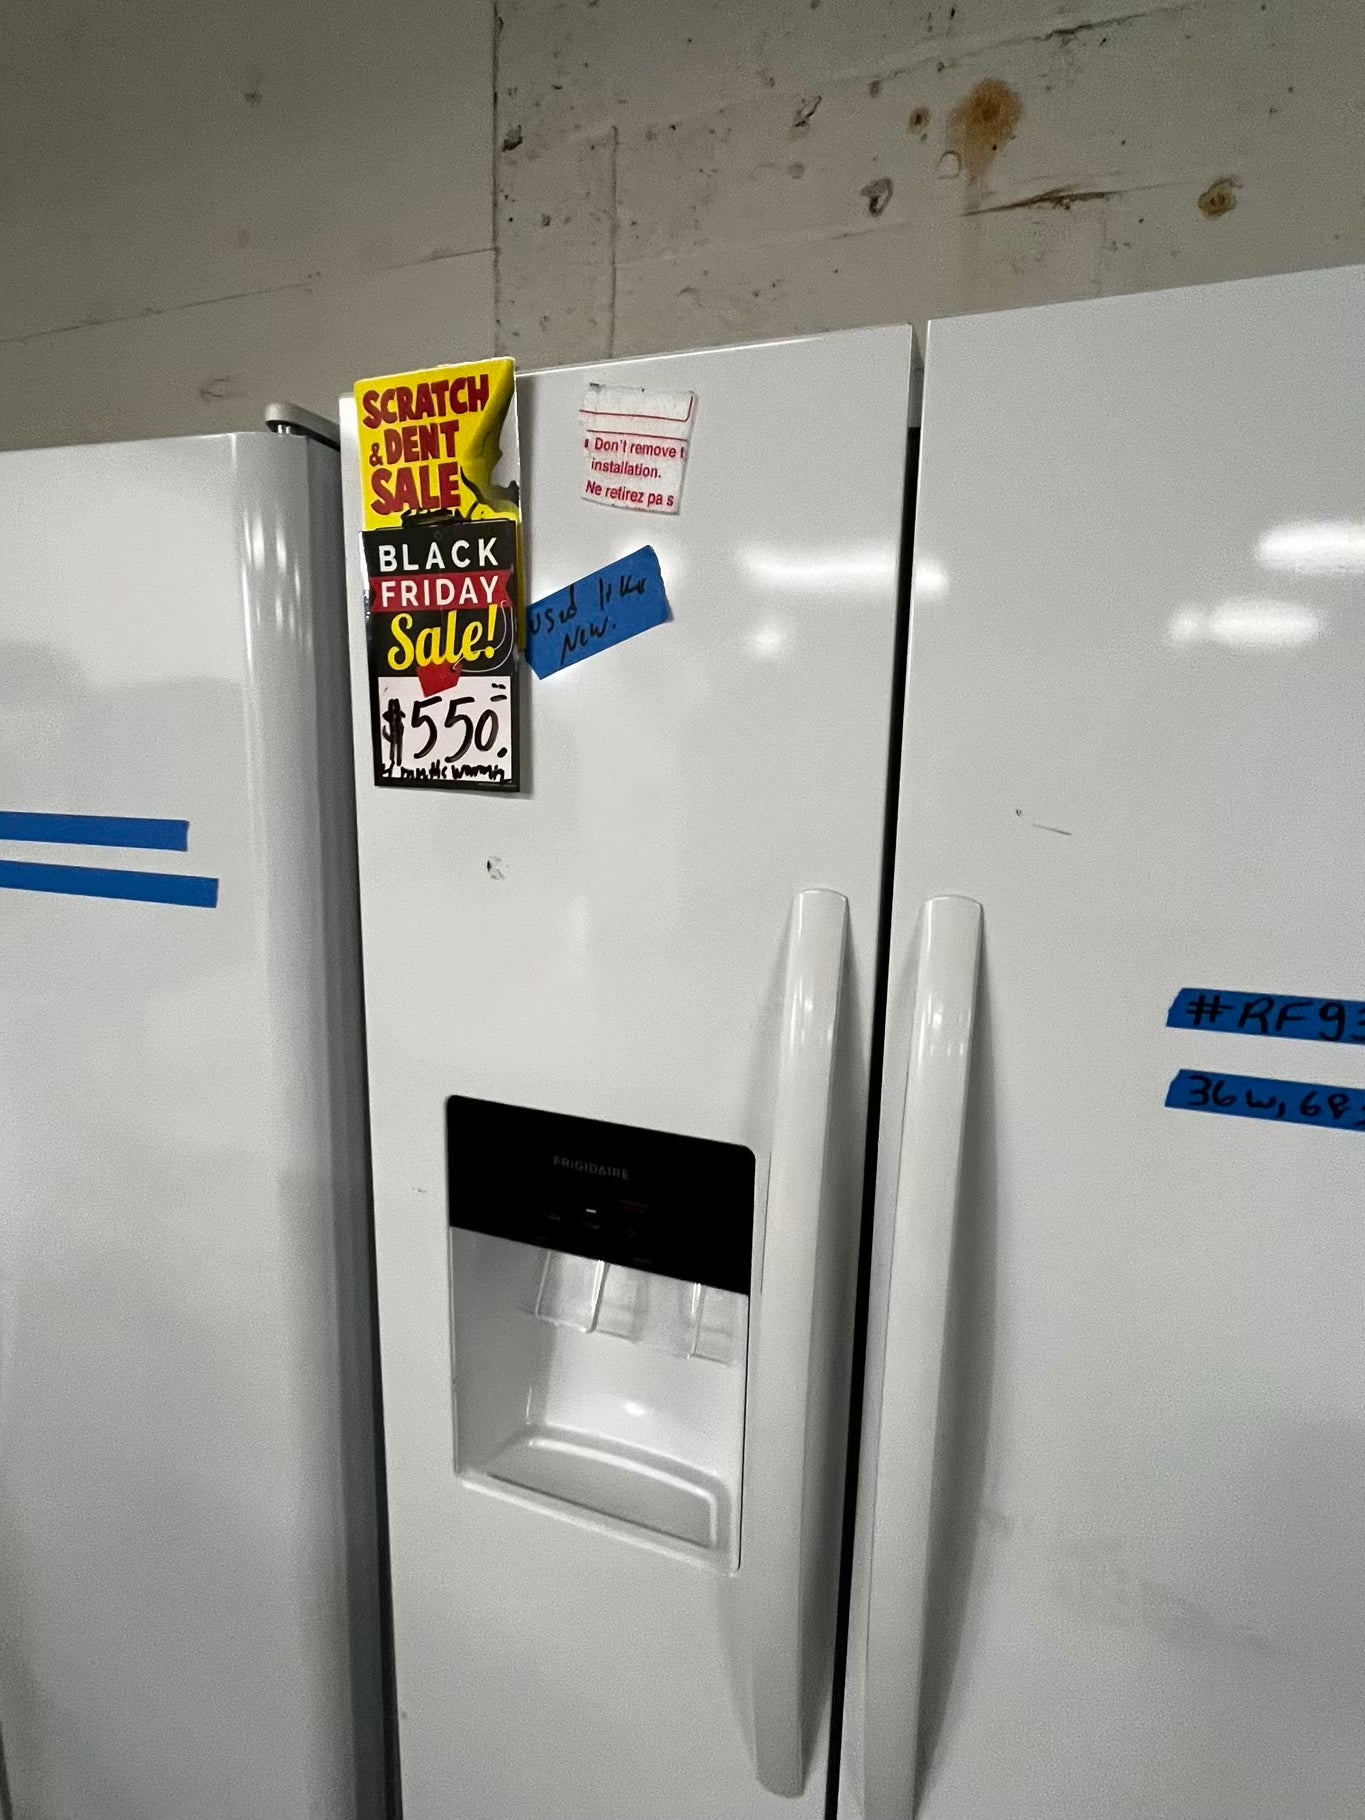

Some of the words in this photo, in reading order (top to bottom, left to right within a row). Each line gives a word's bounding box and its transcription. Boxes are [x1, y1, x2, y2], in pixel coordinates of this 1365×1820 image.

[363, 374, 490, 429] SCRATCH
[369, 442, 383, 467] &
[384, 419, 460, 465] DENT
[594, 437, 627, 453] Don't
[630, 442, 677, 458] remove
[591, 458, 662, 478] installation.
[371, 461, 461, 516] SALE
[585, 480, 602, 495] Ne
[605, 486, 644, 503] retirez
[378, 537, 499, 573] BLACK
[381, 575, 499, 608] FRIDAY
[387, 604, 498, 671] Sale!
[553, 1155, 630, 1181] FRIGIDAIRE
